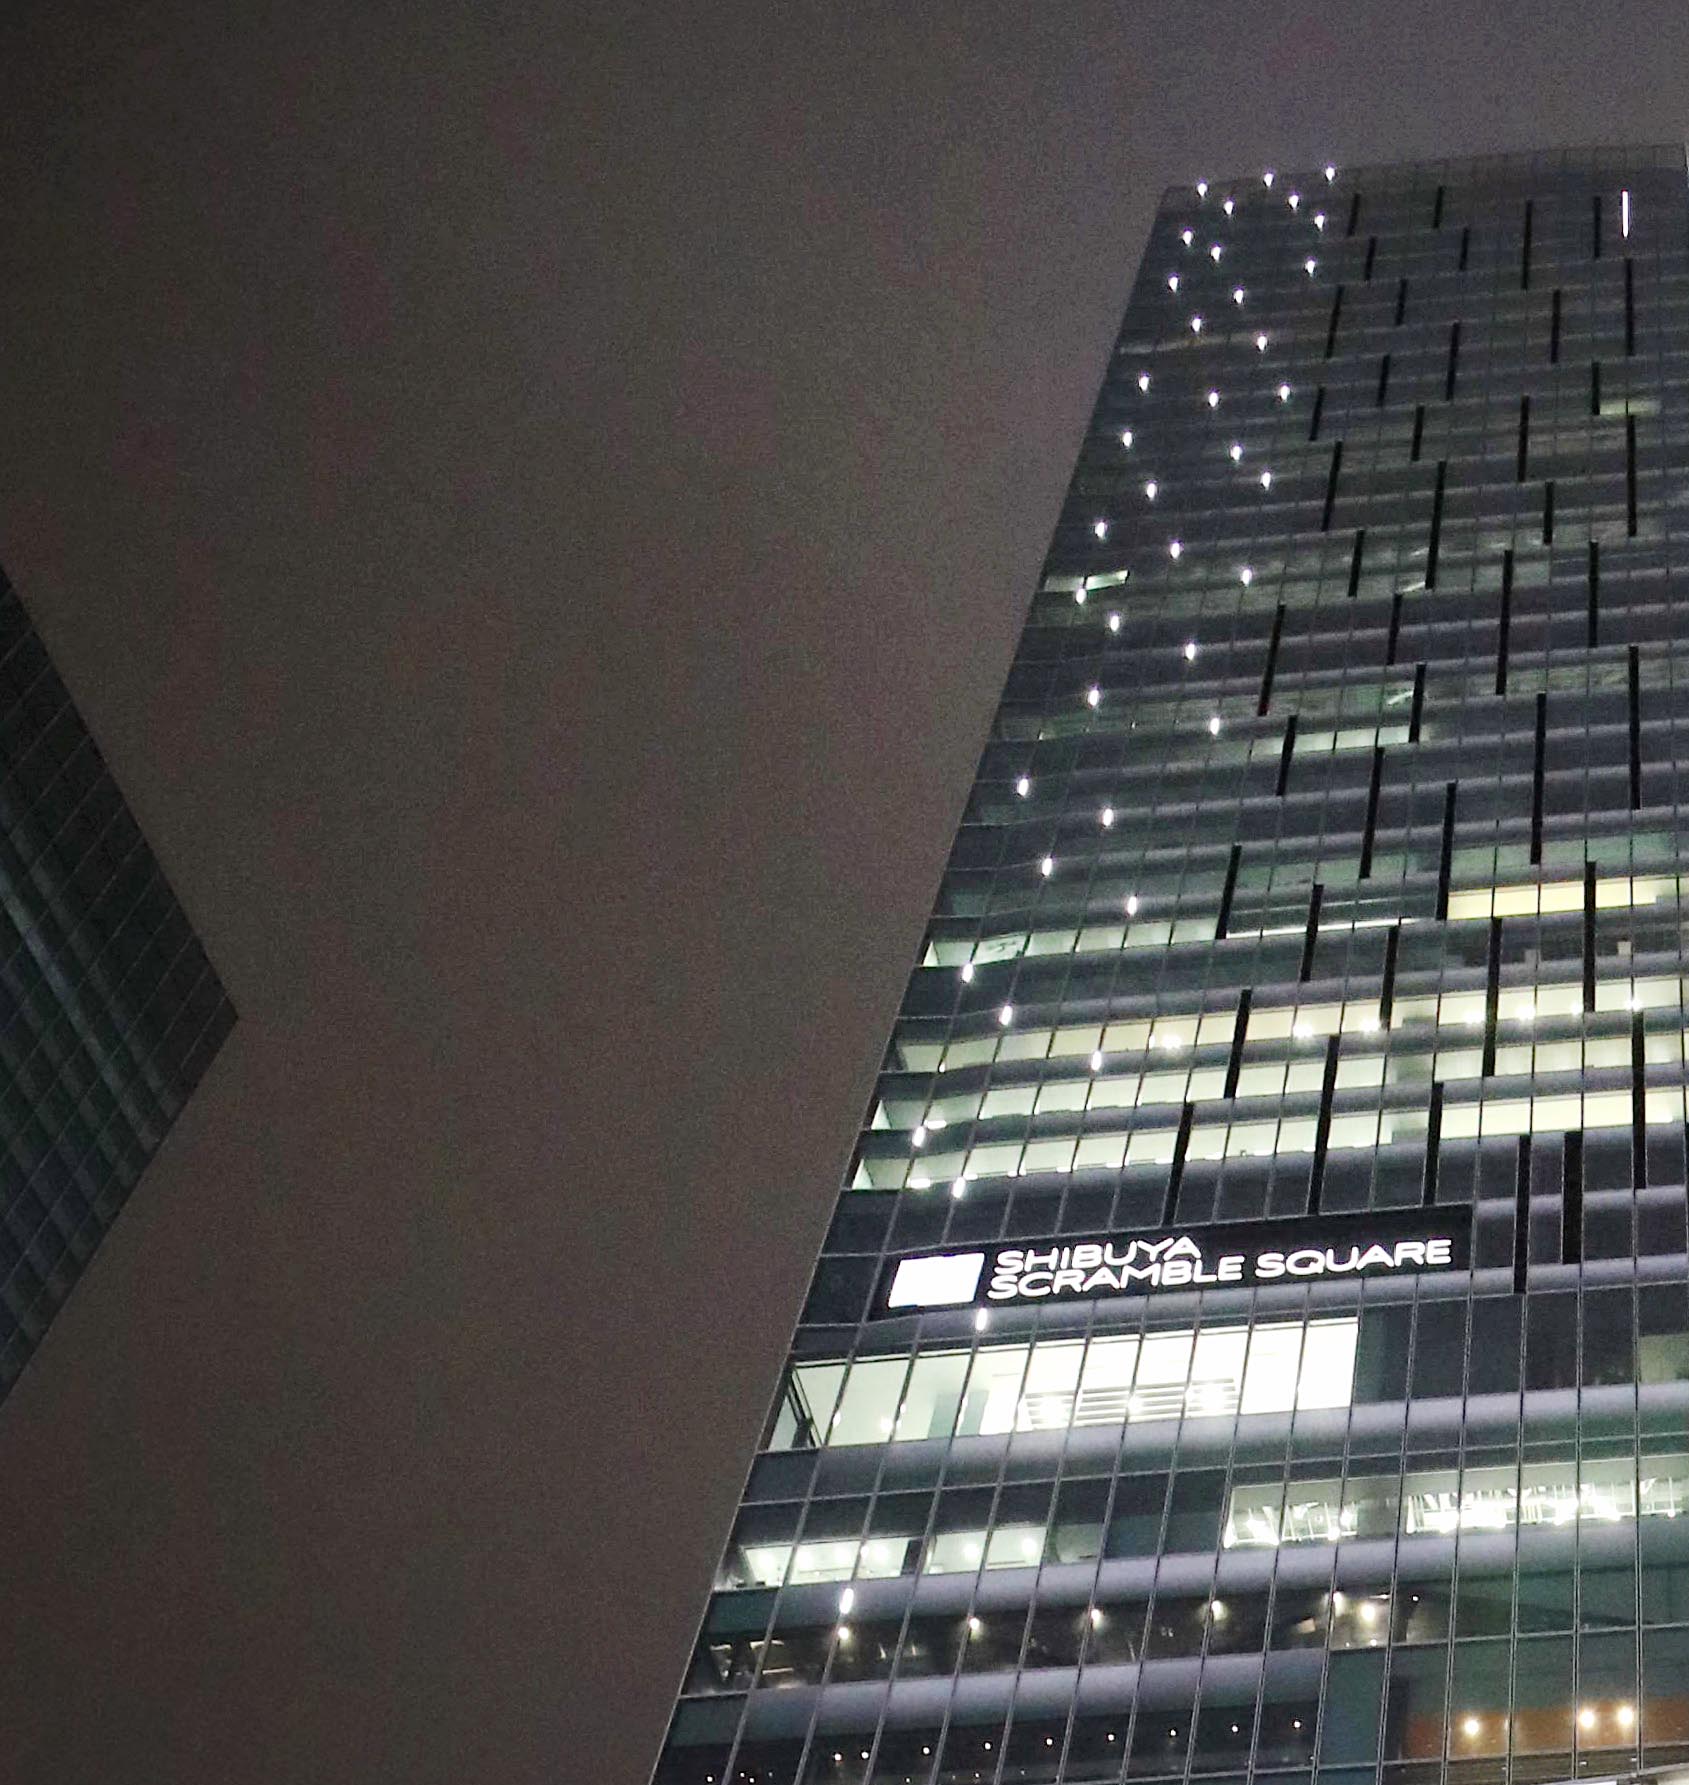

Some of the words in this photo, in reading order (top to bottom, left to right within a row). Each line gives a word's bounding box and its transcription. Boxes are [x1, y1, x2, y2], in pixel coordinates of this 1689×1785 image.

[987, 1255, 1245, 1301] SCRAMBLE
[1254, 1238, 1452, 1279] SQUARE
[994, 1235, 1201, 1276] SHIBUYA
